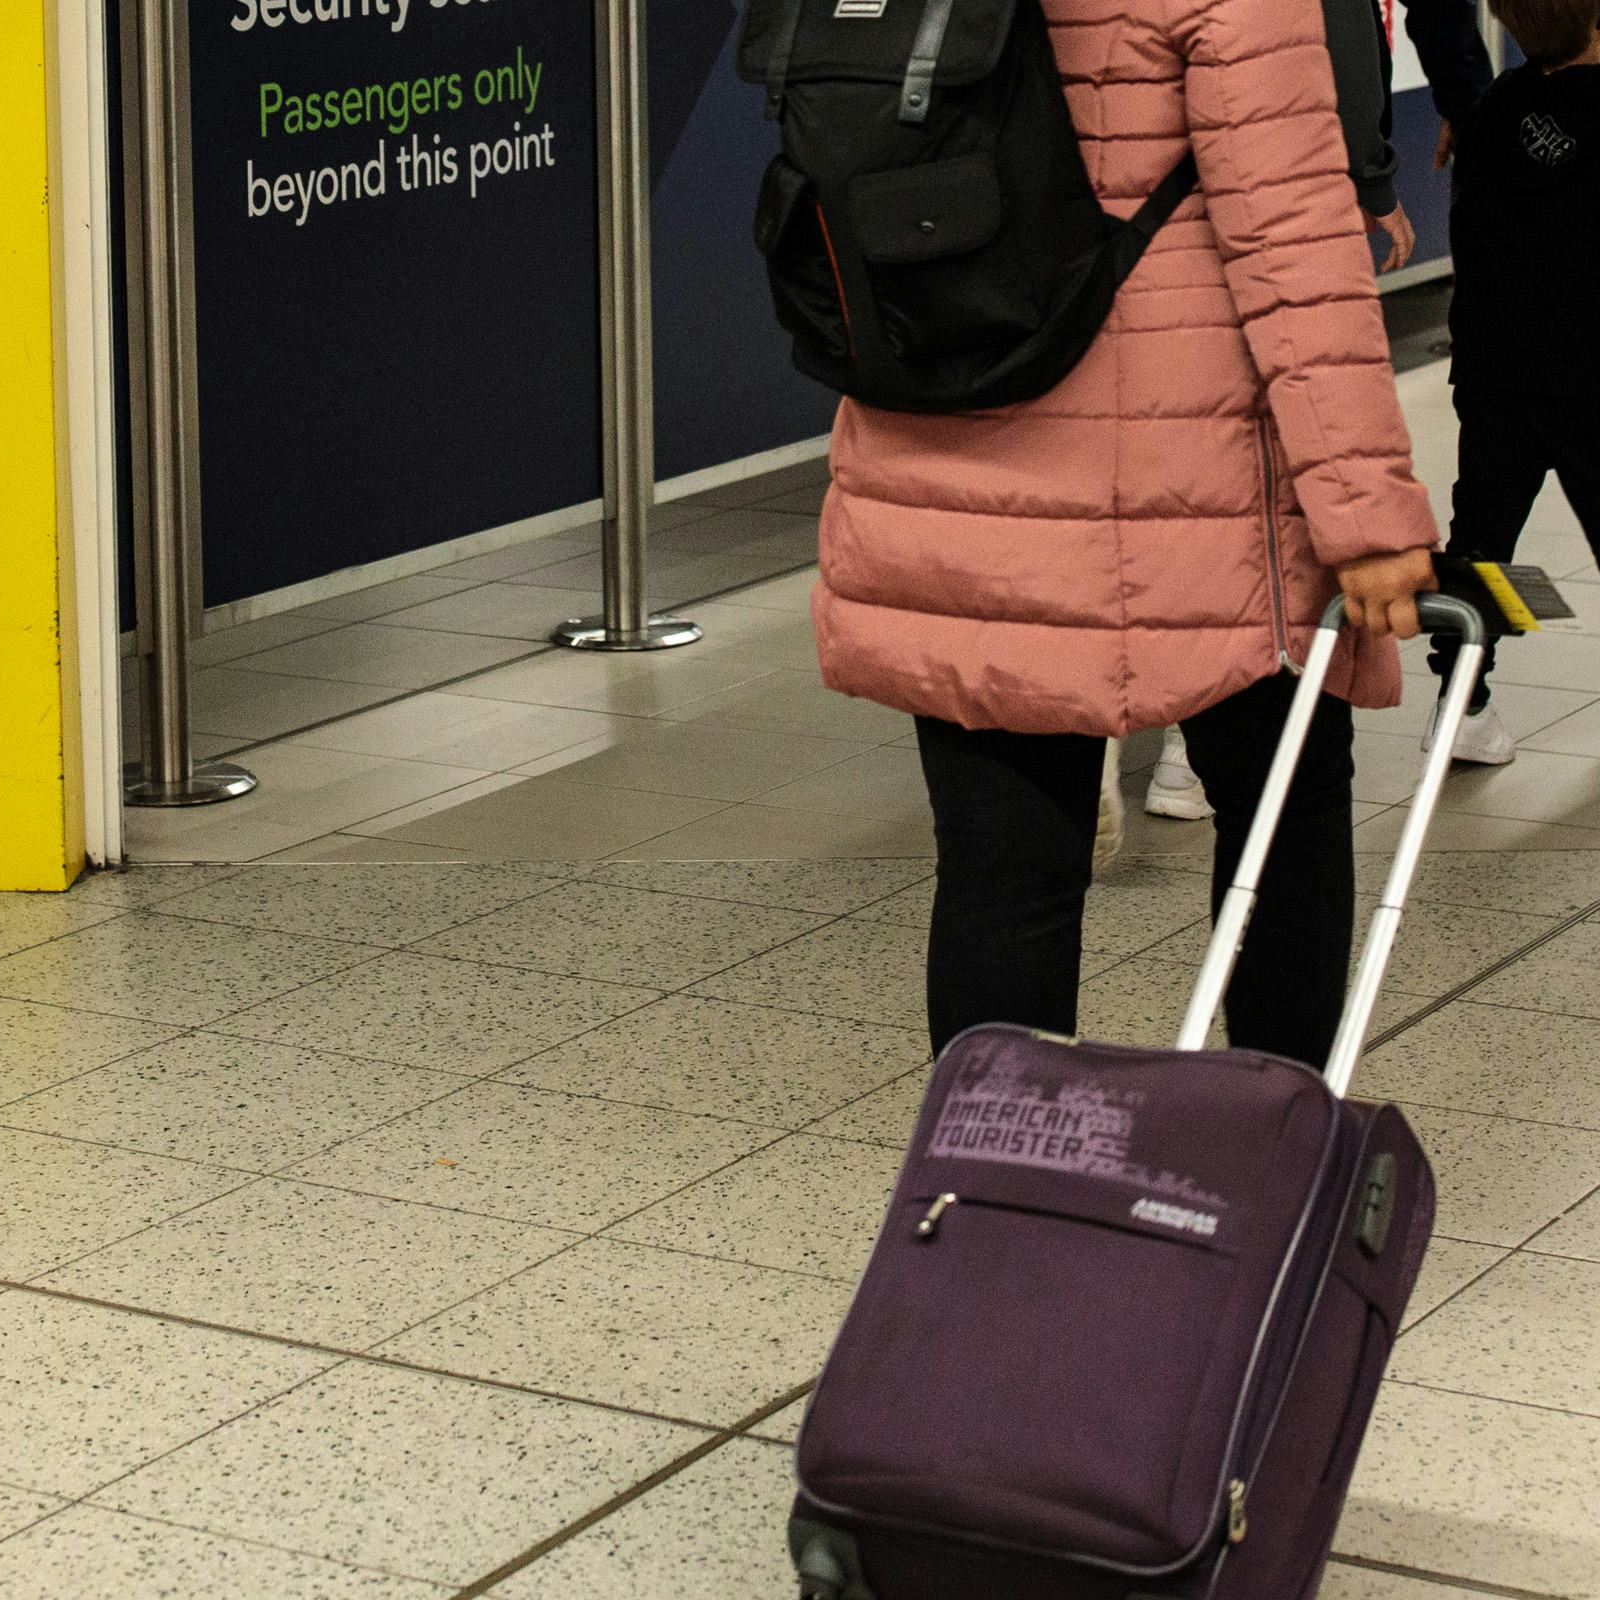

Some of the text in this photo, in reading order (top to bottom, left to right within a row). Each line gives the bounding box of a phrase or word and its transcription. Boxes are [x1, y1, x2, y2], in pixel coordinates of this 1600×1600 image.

[259, 45, 544, 138] Passengers only
[246, 121, 556, 227] beyond this point
[935, 1125, 1083, 1160] TOURISTER
[944, 1101, 1083, 1132] AMERICAN
